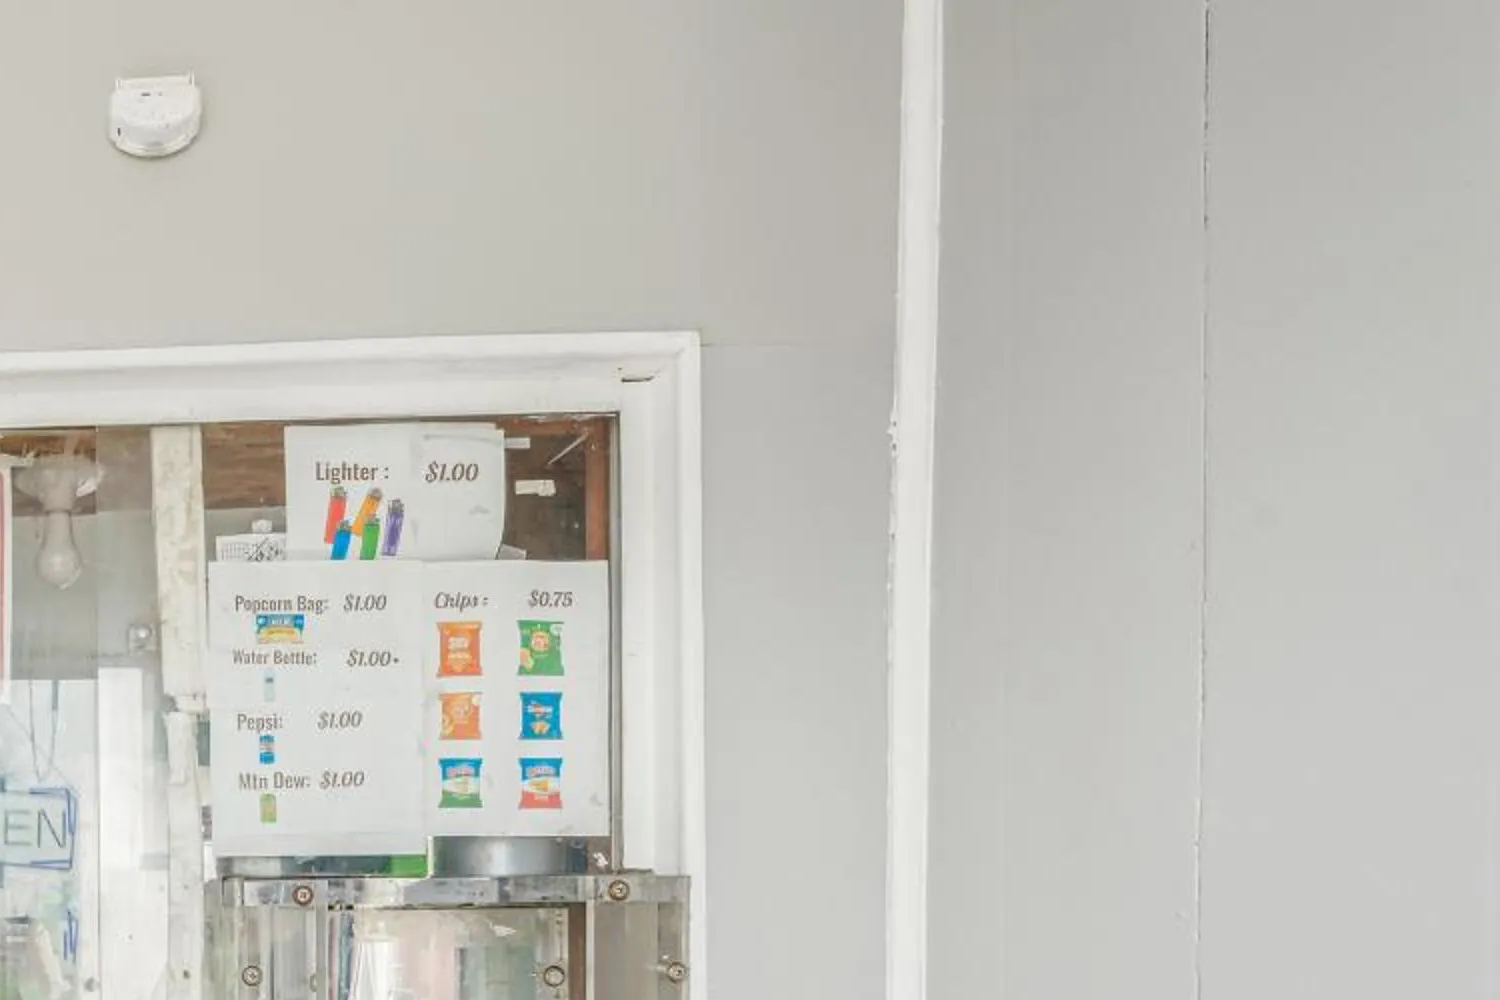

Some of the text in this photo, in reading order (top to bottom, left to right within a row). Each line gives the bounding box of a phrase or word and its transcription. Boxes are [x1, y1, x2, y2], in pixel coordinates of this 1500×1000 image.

[315, 461, 379, 484] Lighter
[425, 461, 479, 483] $1.00
[235, 593, 387, 615] Popcorn Bag: $1.00
[528, 589, 573, 608] $0.75
[233, 649, 269, 665] Water
[273, 649, 317, 665] Bottle:
[237, 710, 363, 733] Pepsi: $1.00
[238, 770, 365, 790] Mtn Dew: $1.00
